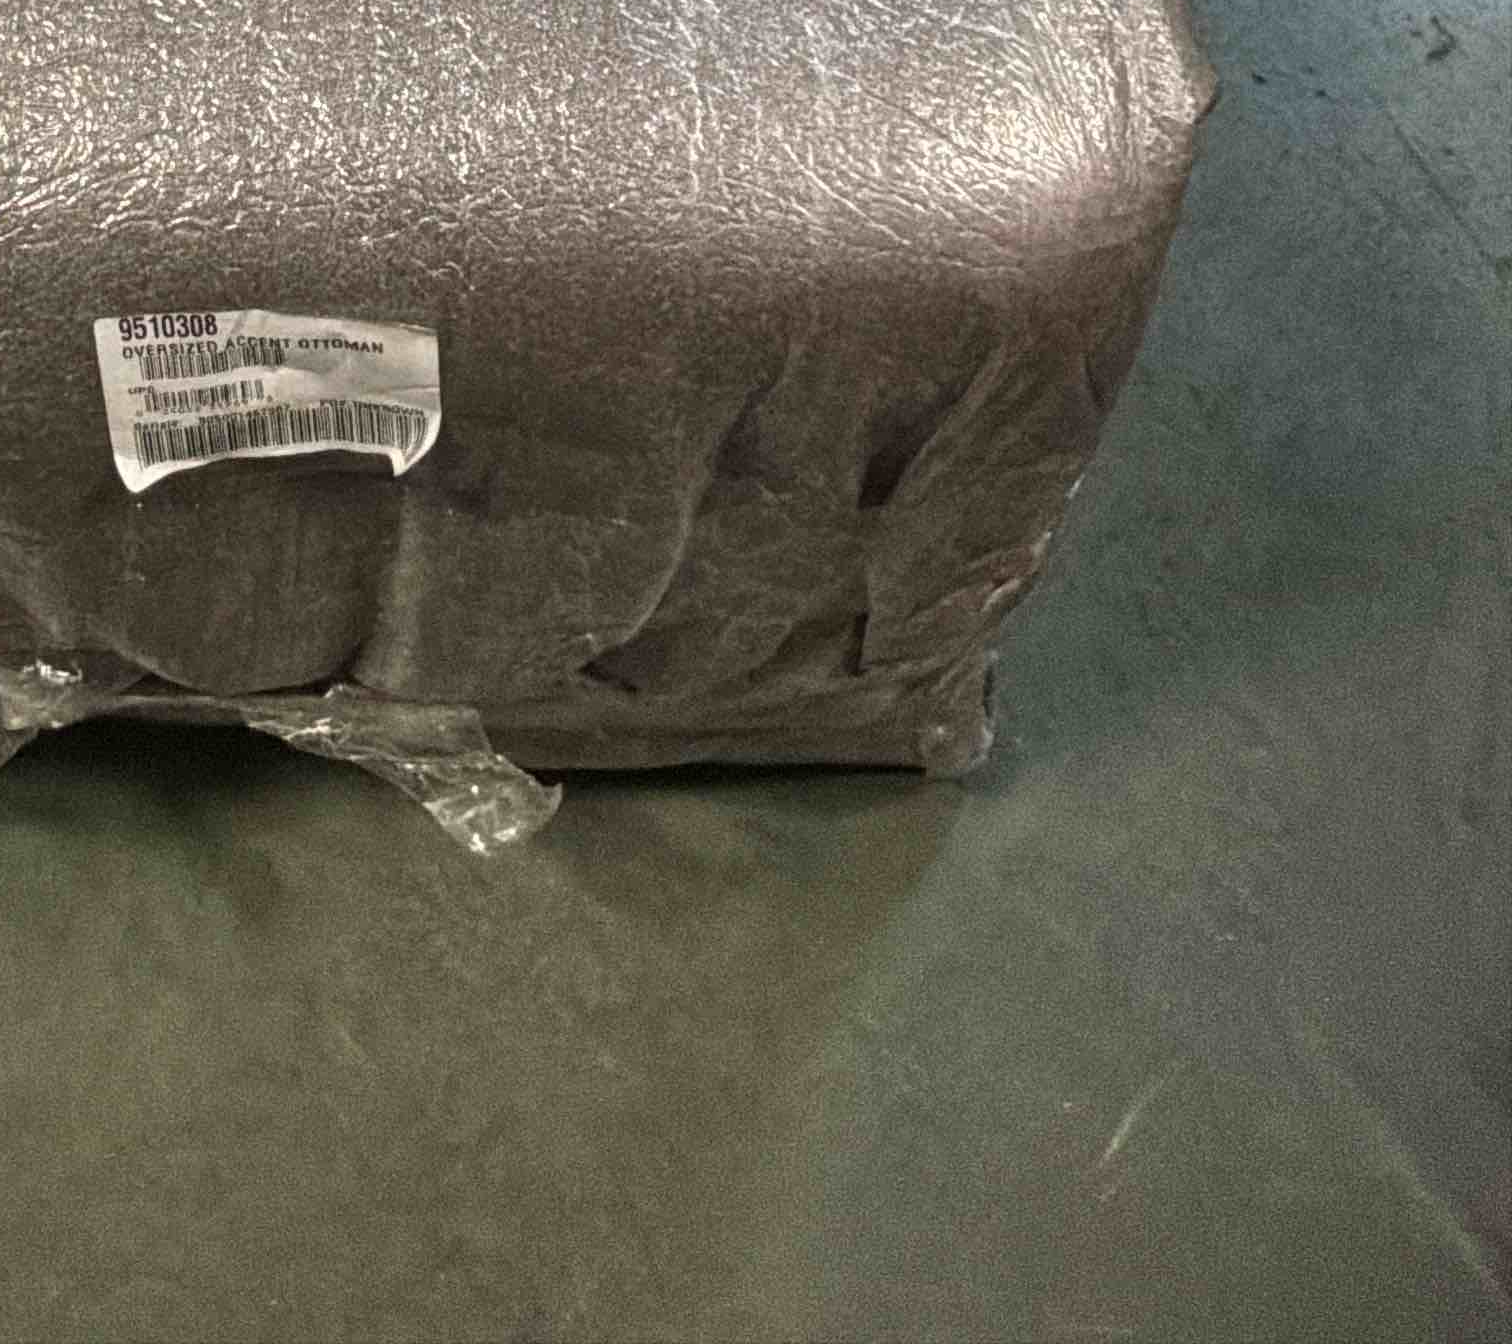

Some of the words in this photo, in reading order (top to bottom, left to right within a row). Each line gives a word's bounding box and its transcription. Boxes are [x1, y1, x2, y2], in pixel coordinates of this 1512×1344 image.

[119, 314, 218, 342] 9510308
[122, 339, 218, 360] OVERSIZED
[225, 335, 291, 354] ACCENT
[297, 338, 384, 355] OTTOMAN
